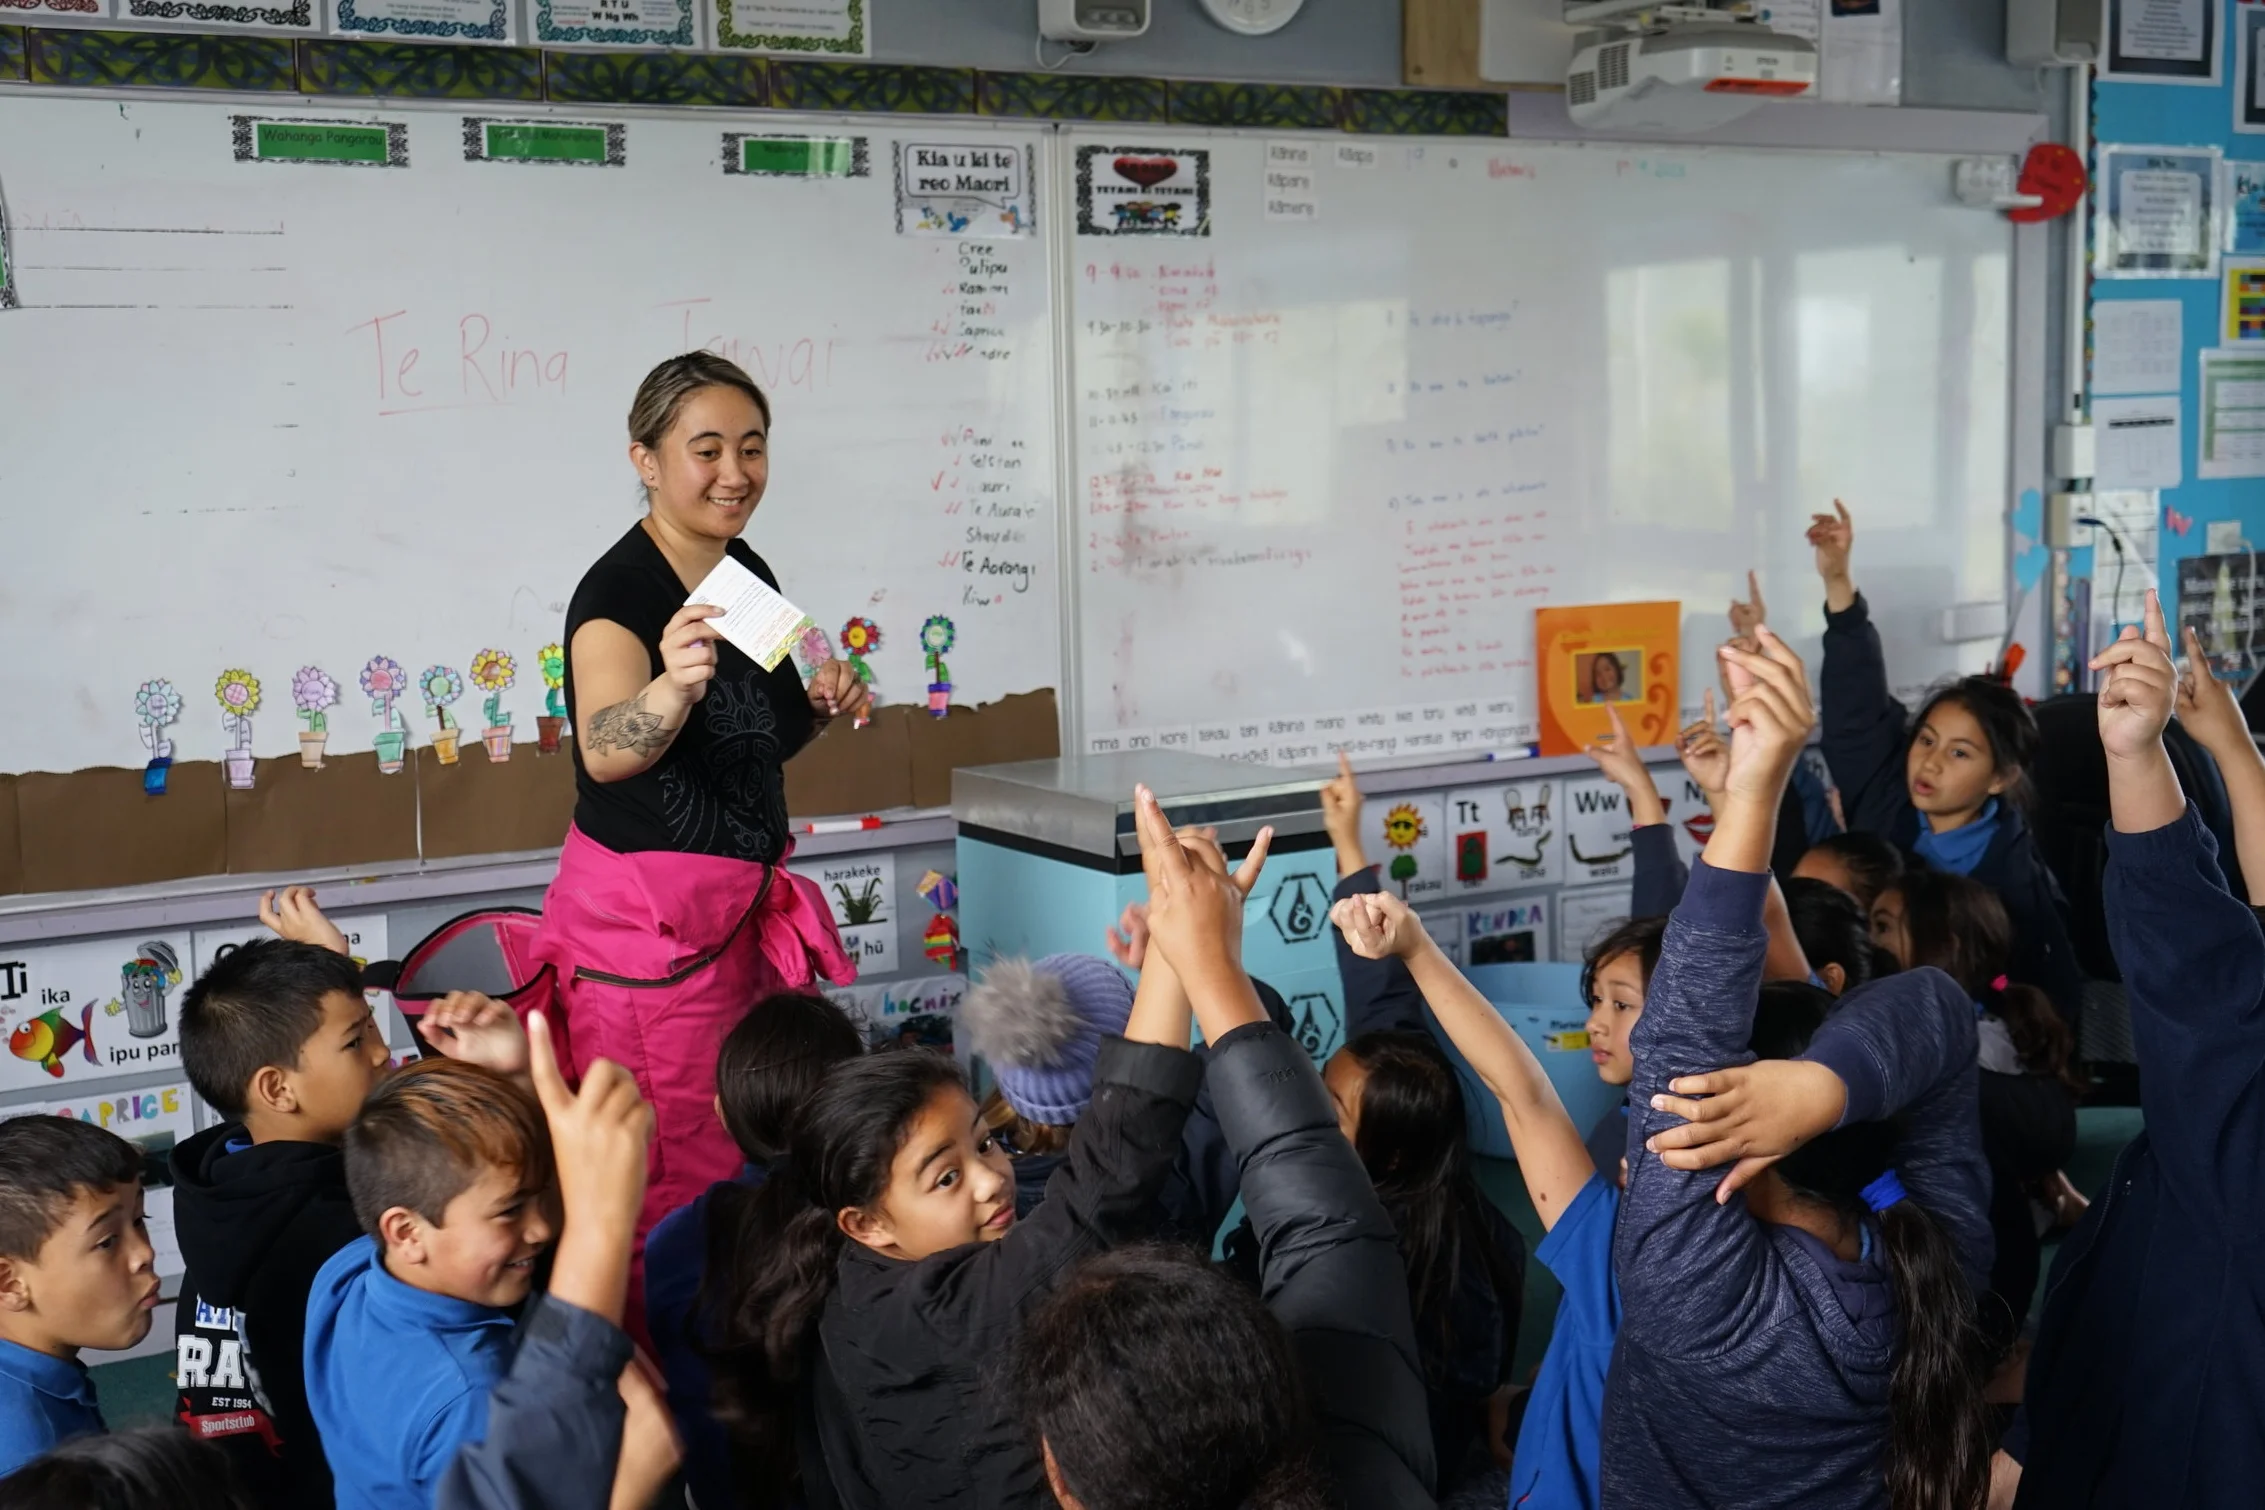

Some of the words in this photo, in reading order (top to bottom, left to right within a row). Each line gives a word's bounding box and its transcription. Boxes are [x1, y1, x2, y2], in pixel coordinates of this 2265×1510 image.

[917, 150, 948, 167] Kia
[971, 152, 988, 168] ki
[995, 152, 1012, 168] te
[919, 179, 950, 190] reo
[956, 175, 1010, 192] Maori
[345, 310, 424, 399] Te
[459, 313, 569, 400] Rina
[961, 551, 974, 572] Te
[1575, 790, 1620, 813] Ww
[1456, 801, 1481, 824] Tt
[824, 864, 881, 882] harakeke
[1467, 904, 1543, 937] KENDRA
[864, 939, 884, 955] hū
[41, 989, 71, 1006] ika
[109, 1046, 140, 1065] ipu
[212, 1397, 231, 1408] EST
[201, 1414, 256, 1433] Sportsclub
